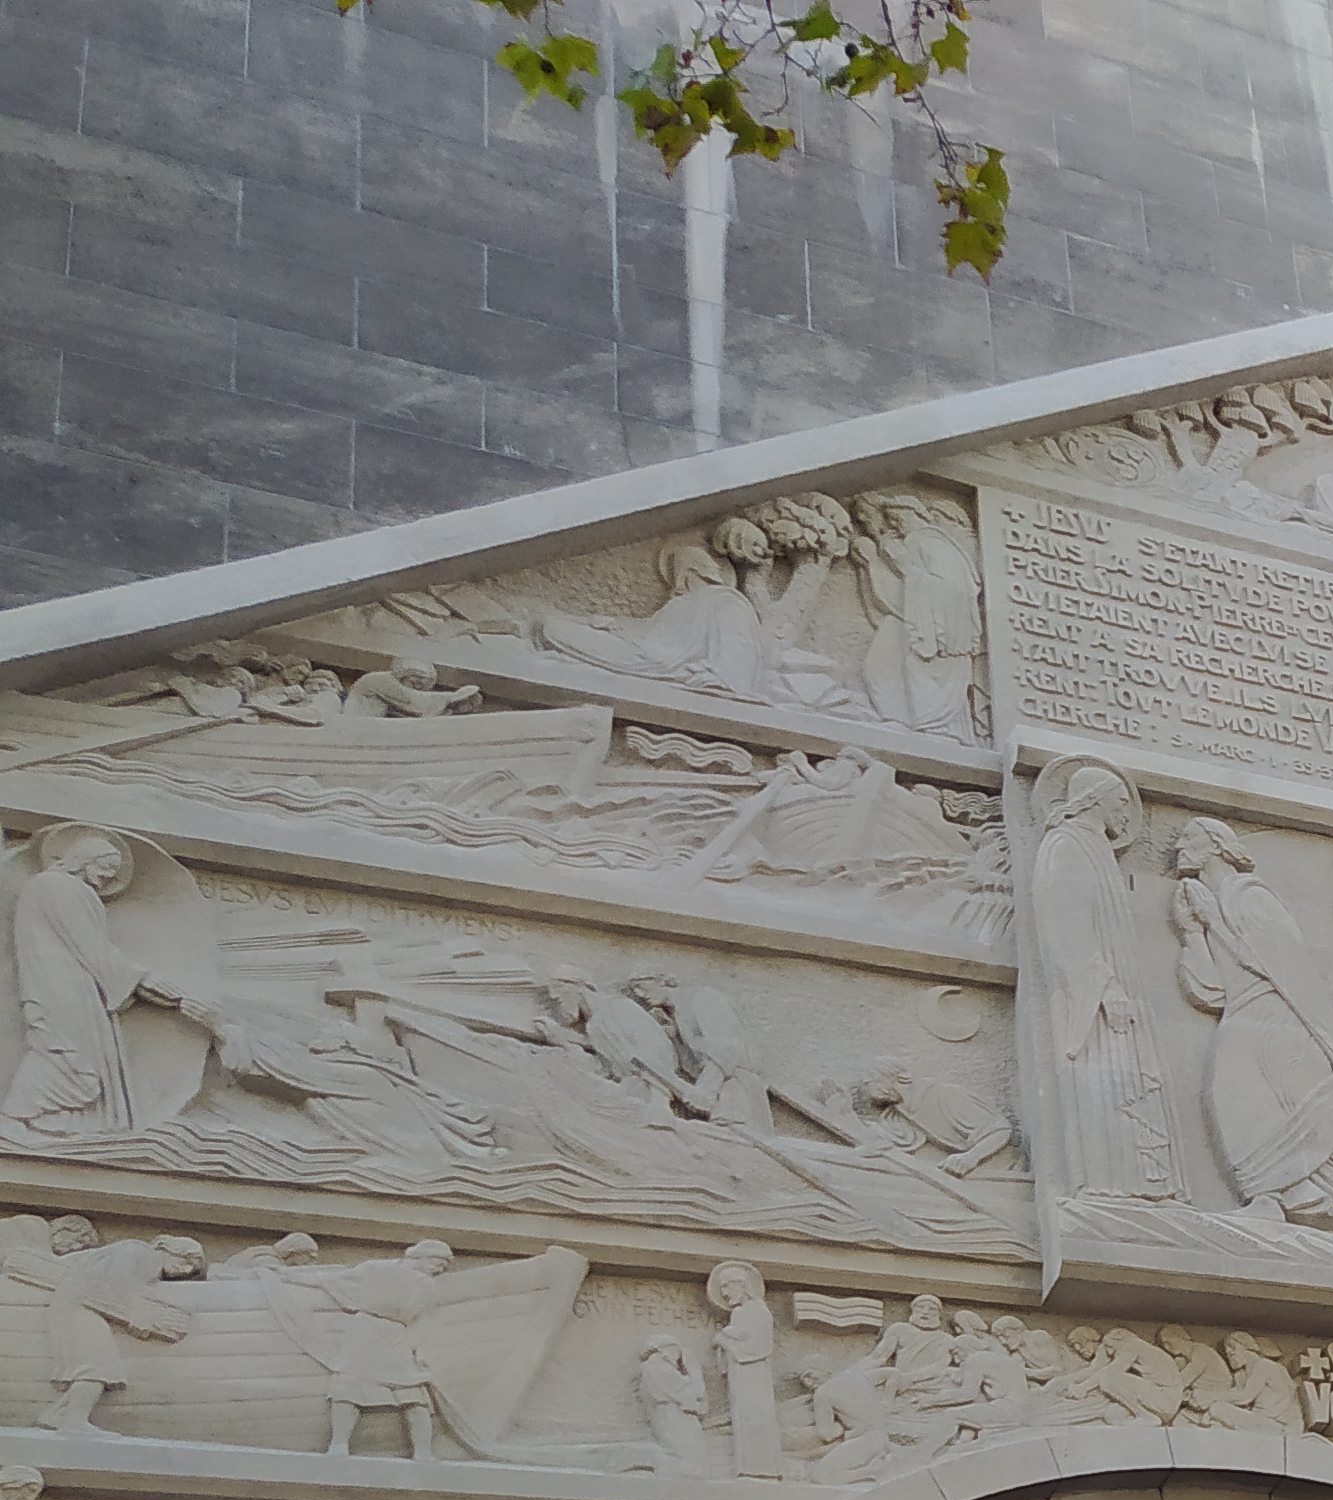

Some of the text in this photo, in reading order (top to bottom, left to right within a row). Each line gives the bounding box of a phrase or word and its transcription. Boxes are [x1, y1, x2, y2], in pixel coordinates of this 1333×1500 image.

[1003, 527, 1087, 567] DANS
[1093, 549, 1134, 579] LA
[1057, 594, 1169, 640] ETAIENT
[1171, 617, 1248, 658] AVEC
[1293, 649, 1331, 677] SE
[1089, 627, 1117, 655] A
[1123, 636, 1166, 665] SA
[1016, 697, 1144, 741] CHERCHE
[1099, 676, 1174, 719] TOVT
[1176, 701, 1214, 729] LE
[1214, 710, 1313, 751] MONDE
